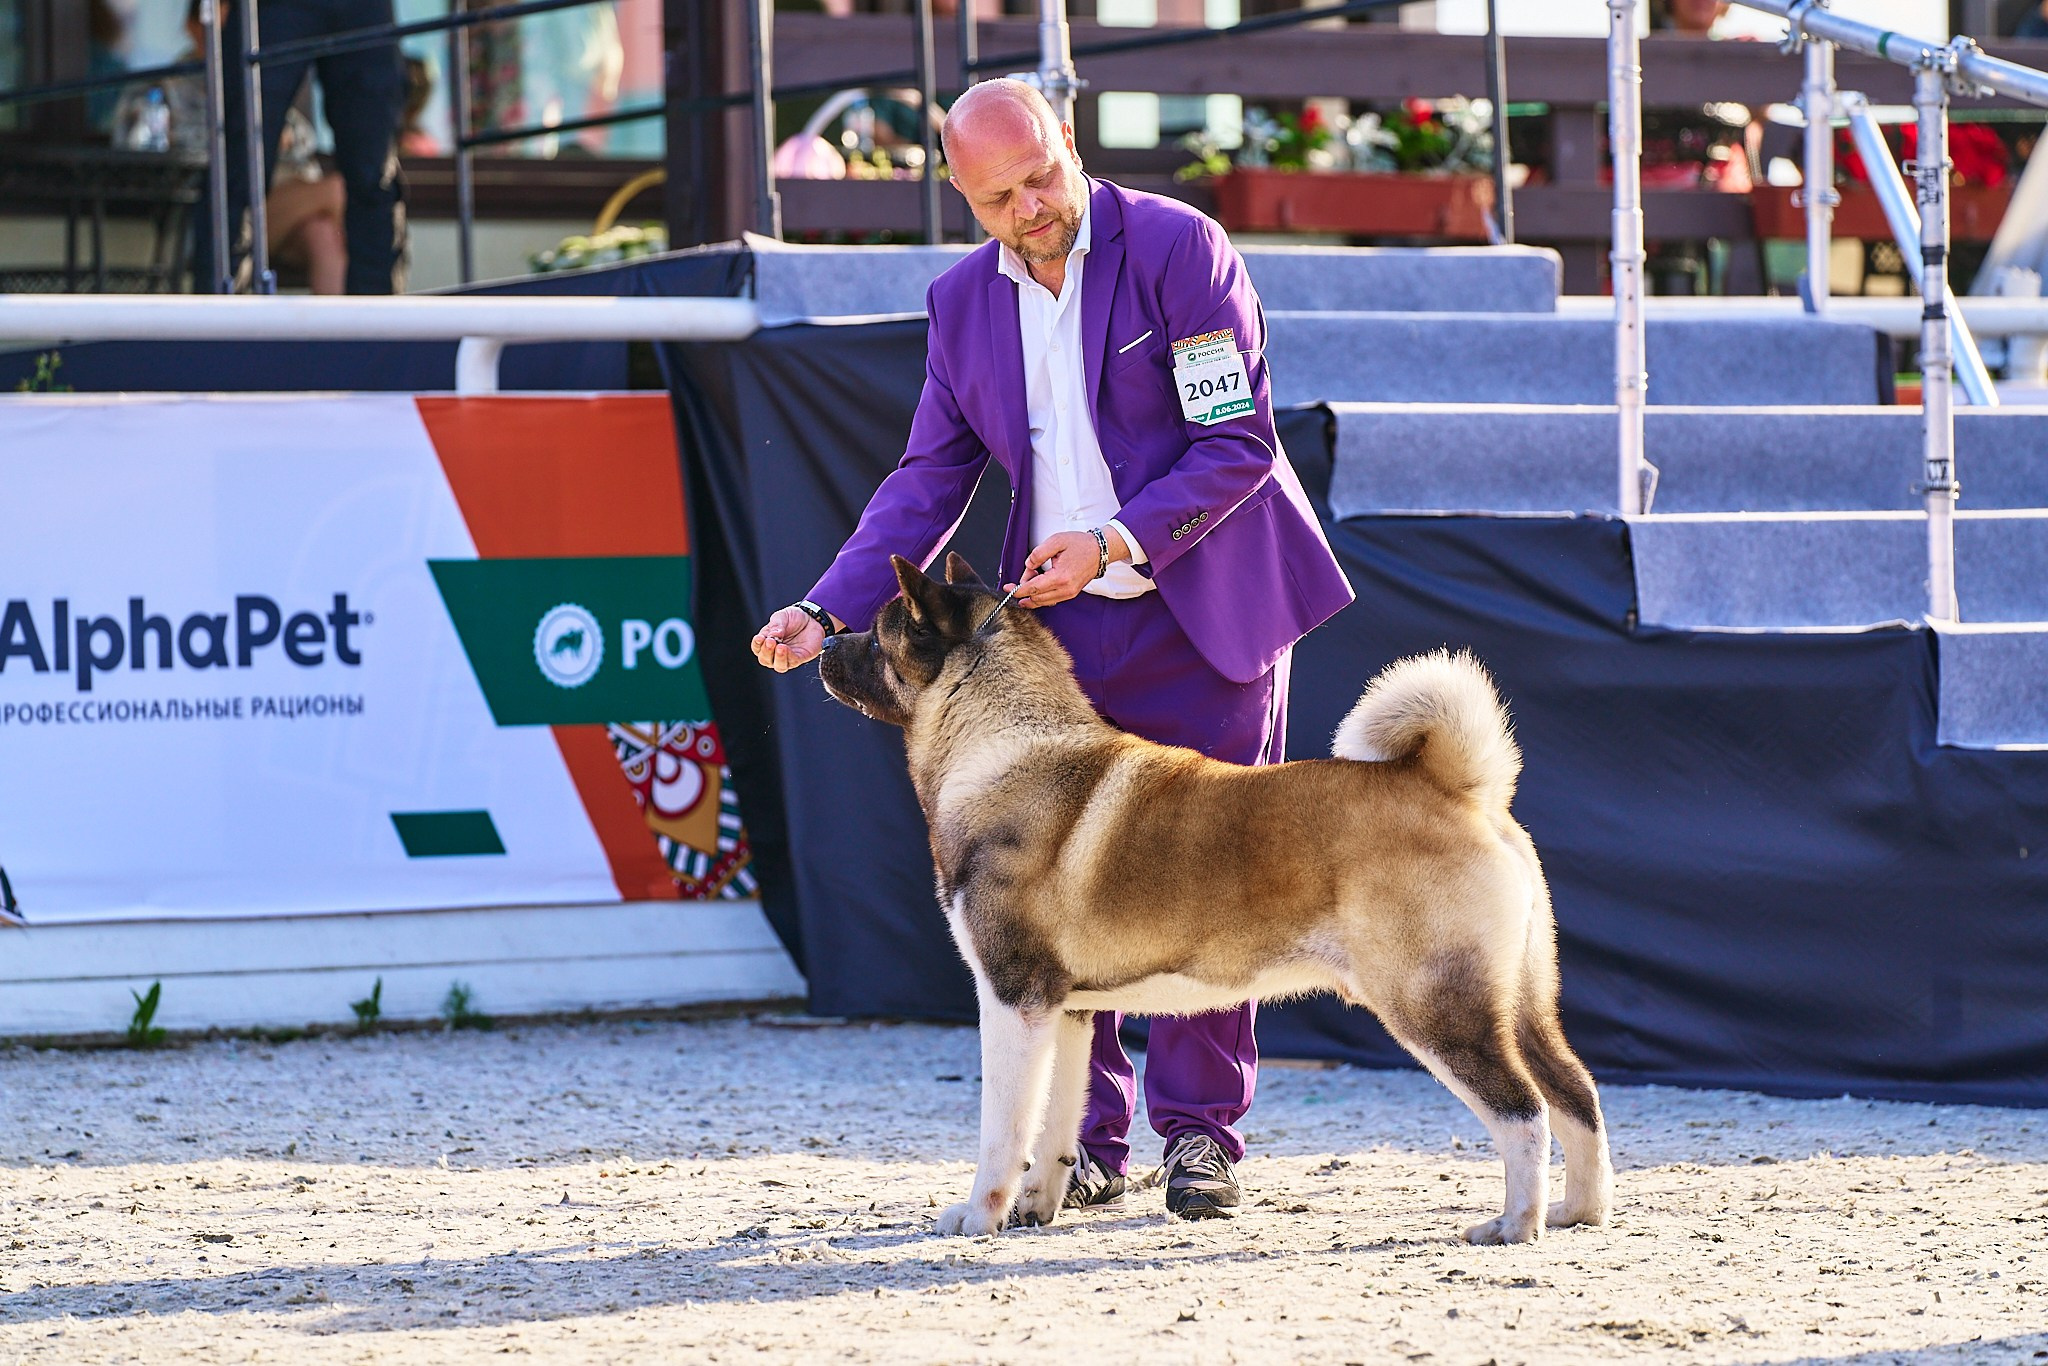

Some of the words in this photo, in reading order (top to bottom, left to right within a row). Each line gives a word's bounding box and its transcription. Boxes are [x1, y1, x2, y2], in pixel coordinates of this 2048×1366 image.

[1197, 347, 1225, 358] РОССИЯ
[1184, 371, 1241, 402] 2047
[1215, 401, 1250, 415] 8.06.2024
[0, 592, 362, 692] AlphaPet
[0, 697, 243, 725] РОФЕССИОНАЛЬНЫЕ
[251, 694, 365, 722] РАЦИОНЫ
